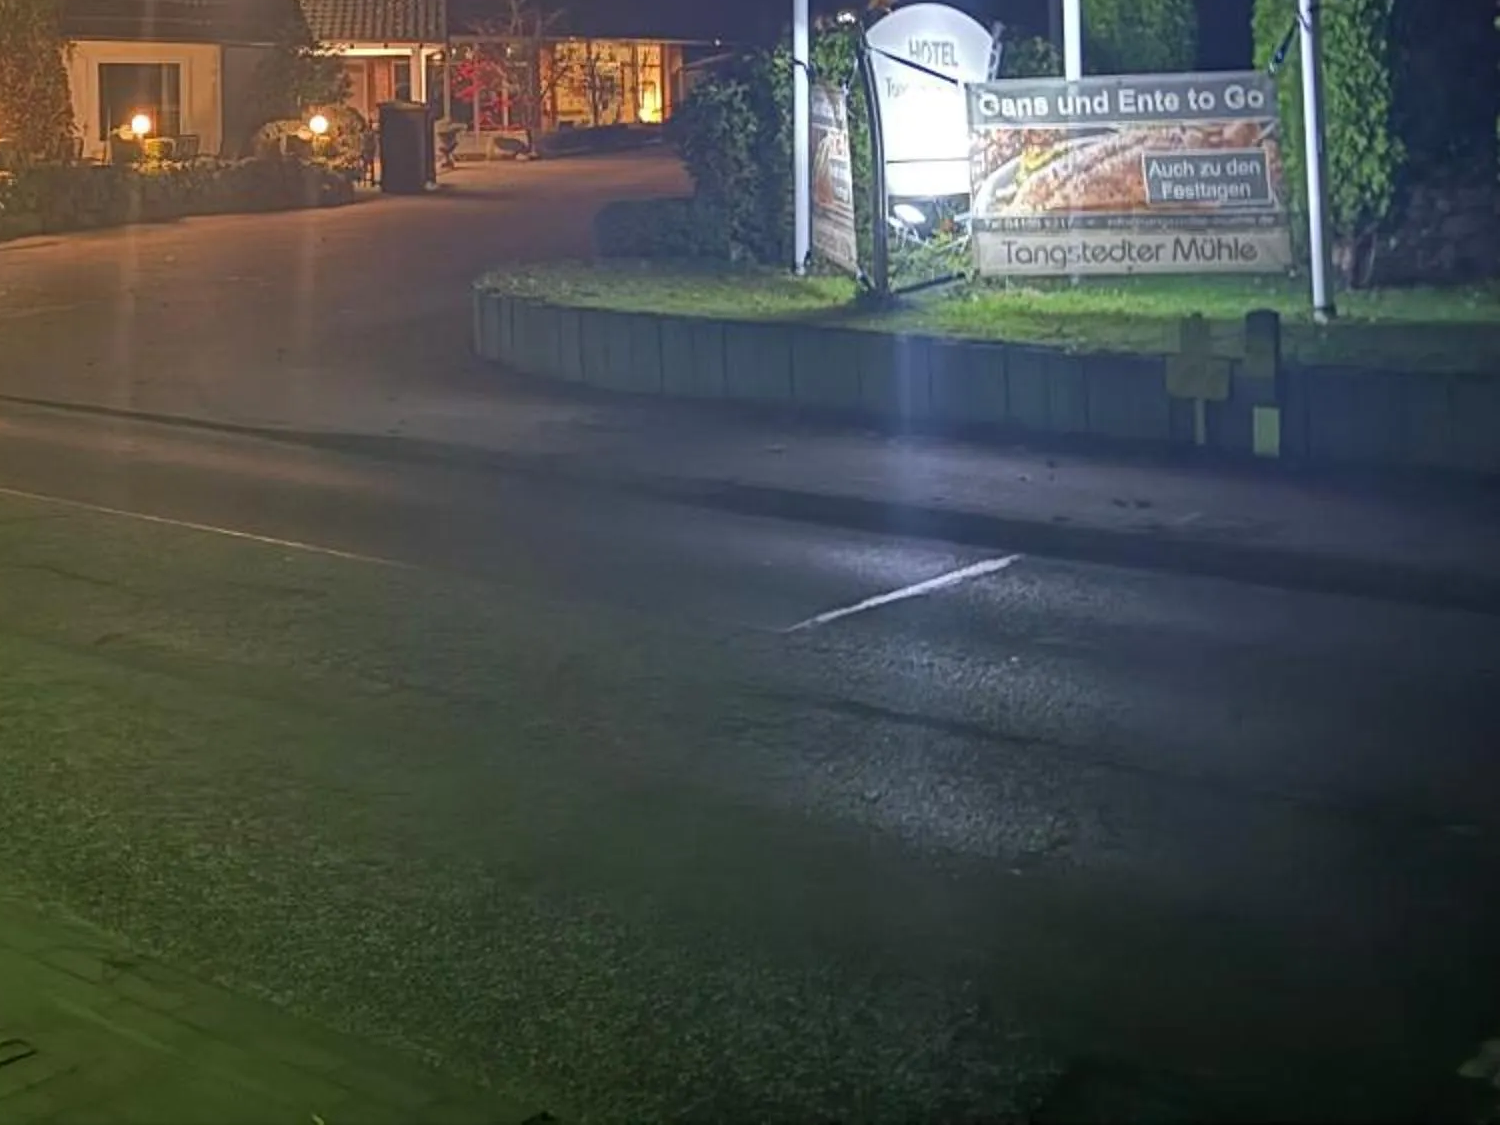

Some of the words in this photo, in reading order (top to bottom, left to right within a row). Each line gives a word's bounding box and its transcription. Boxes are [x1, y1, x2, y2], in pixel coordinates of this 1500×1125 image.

[908, 39, 959, 67] HOTEL
[979, 92, 1049, 117] Gans
[1057, 89, 1109, 116] und
[1118, 87, 1180, 114] Ente
[1188, 86, 1215, 111] to
[1224, 84, 1264, 110] Go
[1148, 158, 1195, 179] Auch
[1200, 161, 1221, 177] zu
[1225, 157, 1261, 176] den
[1161, 179, 1252, 202] Festtagen
[1001, 238, 1167, 269] Tangstedter
[1172, 236, 1258, 263] Mühle
